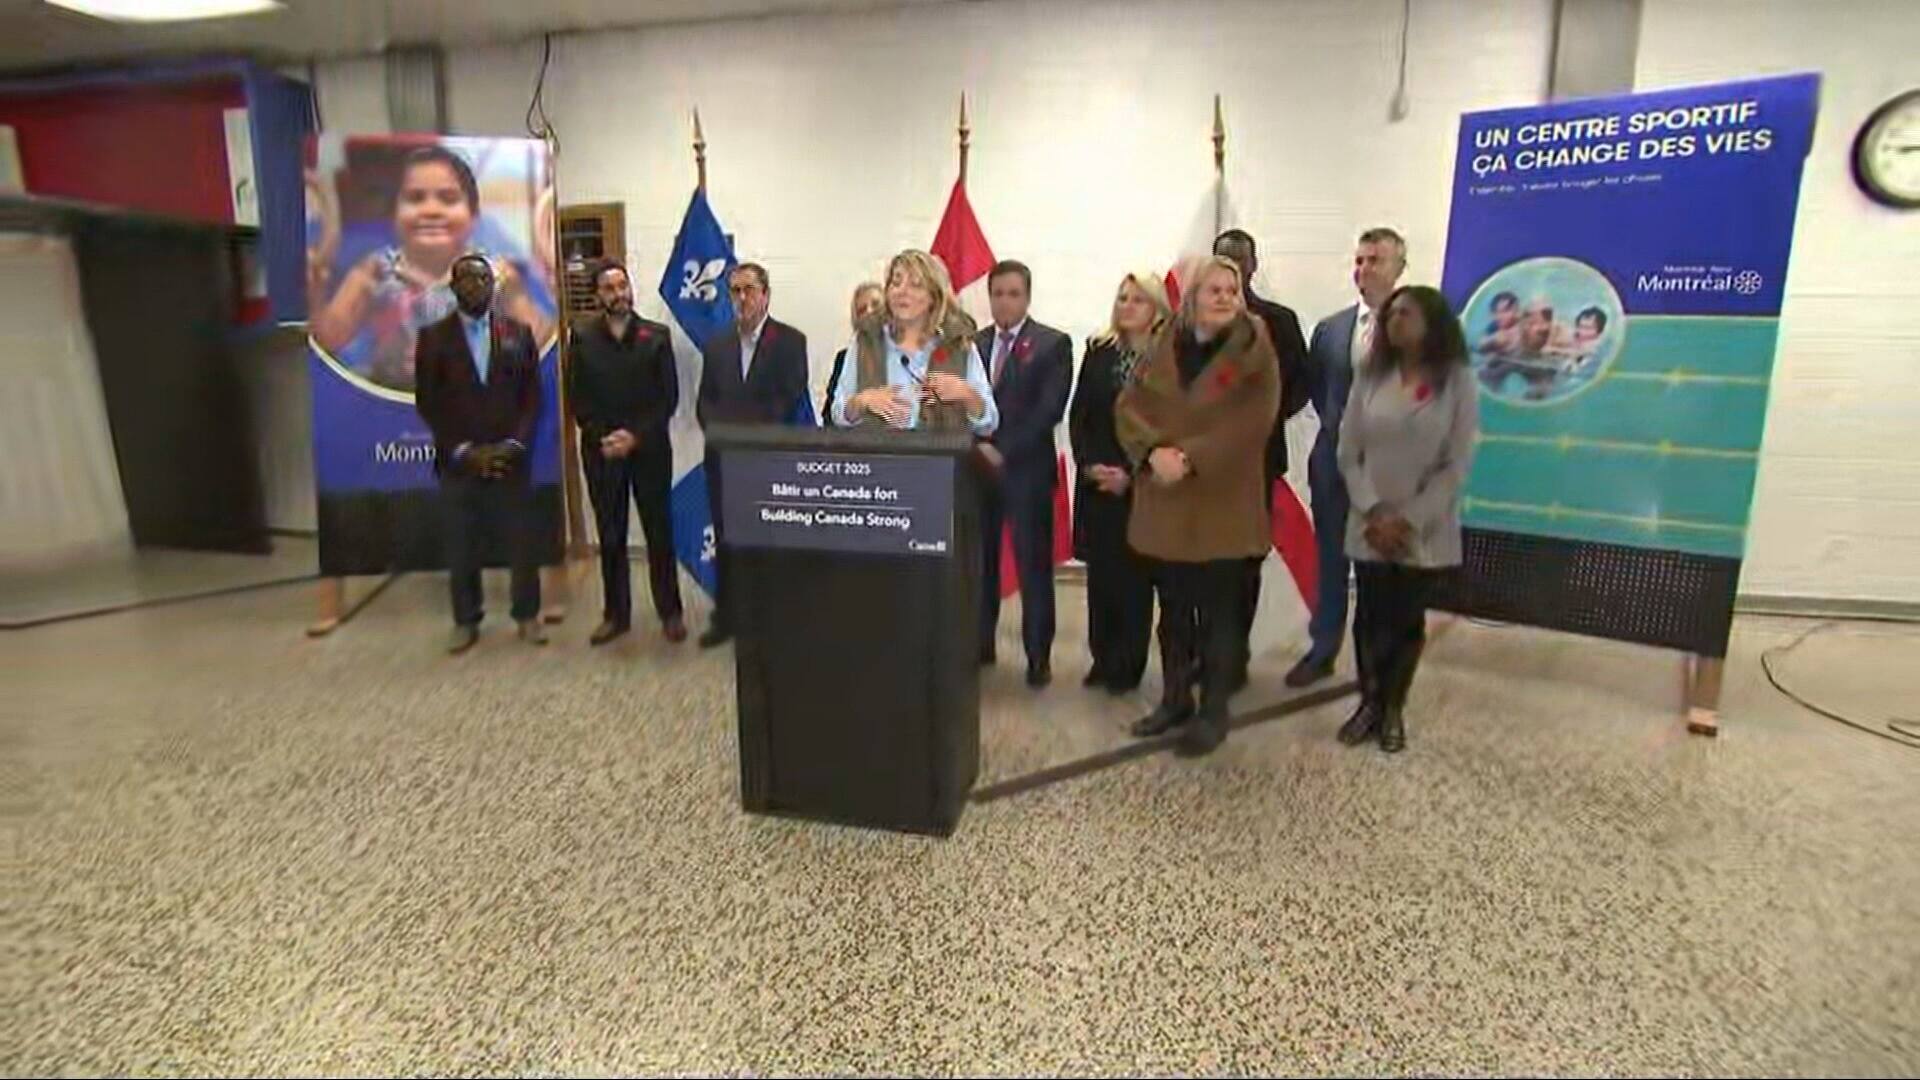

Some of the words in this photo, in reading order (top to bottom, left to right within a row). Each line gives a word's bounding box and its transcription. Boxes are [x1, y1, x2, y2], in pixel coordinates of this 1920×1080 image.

[1475, 128, 1509, 148] UN
[1517, 115, 1621, 142] CENTRE
[1628, 101, 1758, 133] SPORTIF
[1472, 154, 1508, 178] ÇA
[1515, 142, 1631, 170] CHANGE
[1639, 135, 1696, 160] DES
[1705, 128, 1772, 153] VIES
[1637, 274, 1731, 291] Montréal
[797, 461, 841, 474] BUDGET
[844, 462, 872, 476] 2025
[772, 482, 800, 496] Bâtir
[803, 487, 820, 497] un
[822, 484, 872, 499] Canada
[874, 485, 898, 500] fort
[760, 507, 813, 526] Building
[815, 510, 864, 525] Canada
[866, 512, 910, 530] Strong
